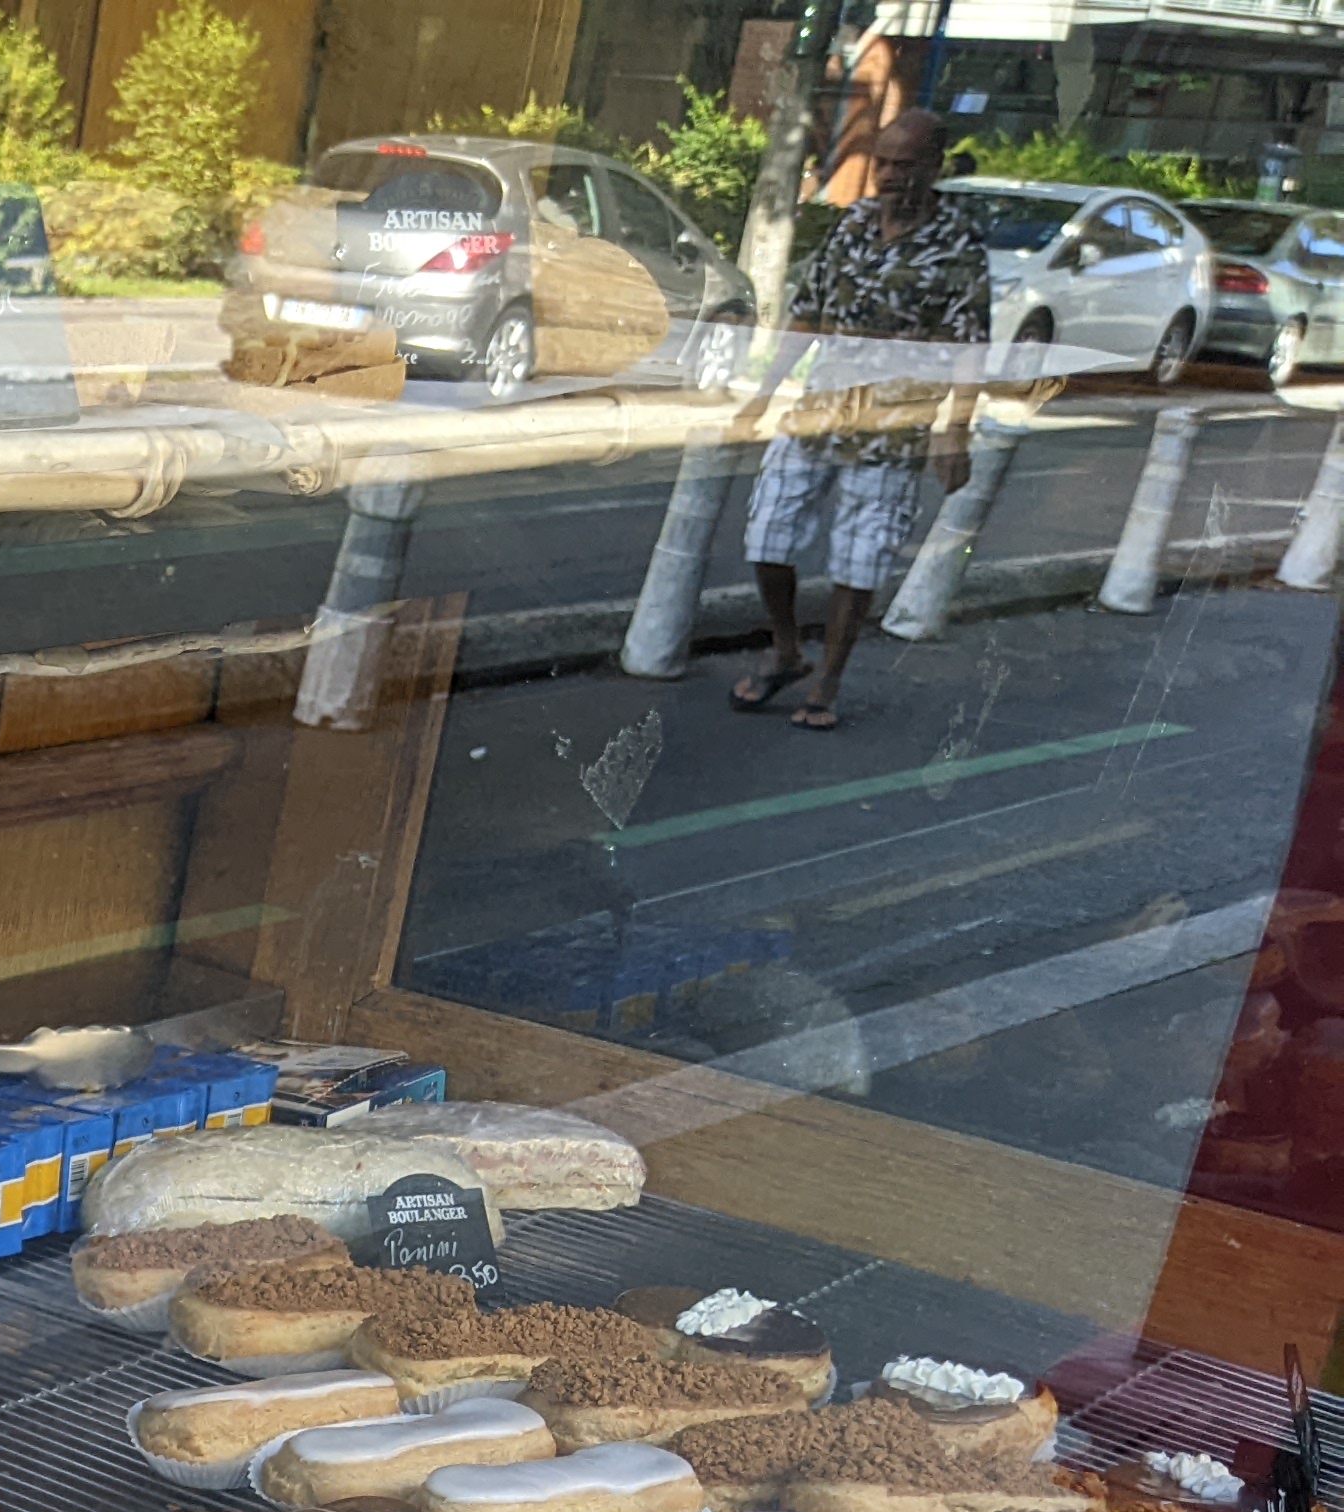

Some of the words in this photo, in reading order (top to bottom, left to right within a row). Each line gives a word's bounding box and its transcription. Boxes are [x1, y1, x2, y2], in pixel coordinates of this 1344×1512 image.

[383, 209, 483, 231] ARTISAN
[394, 1193, 455, 1209] ARTISAN
[387, 1208, 468, 1224] BOULANGER
[384, 1228, 457, 1266] Panini
